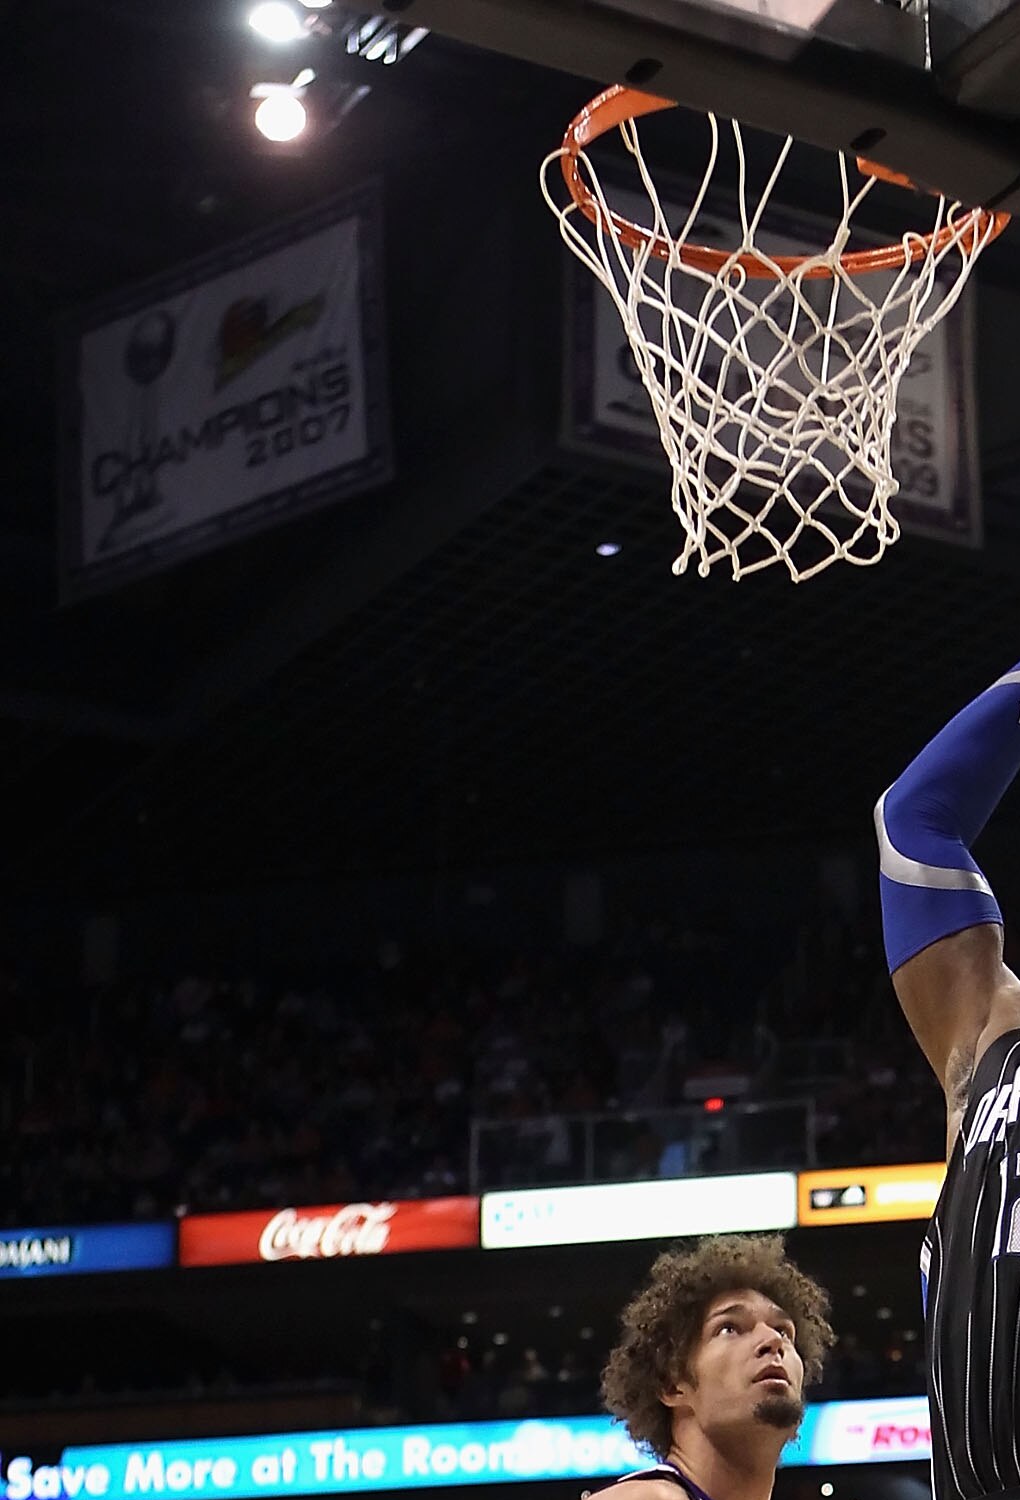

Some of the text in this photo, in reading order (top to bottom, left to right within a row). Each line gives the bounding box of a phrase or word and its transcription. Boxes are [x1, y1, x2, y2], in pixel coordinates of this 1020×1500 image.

[91, 362, 350, 497] CHAMPIONS
[246, 403, 350, 468] 2007
[5, 1456, 110, 1500] Save
[123, 1450, 237, 1493] More
[251, 1447, 297, 1486] at
[311, 1437, 387, 1481] The
